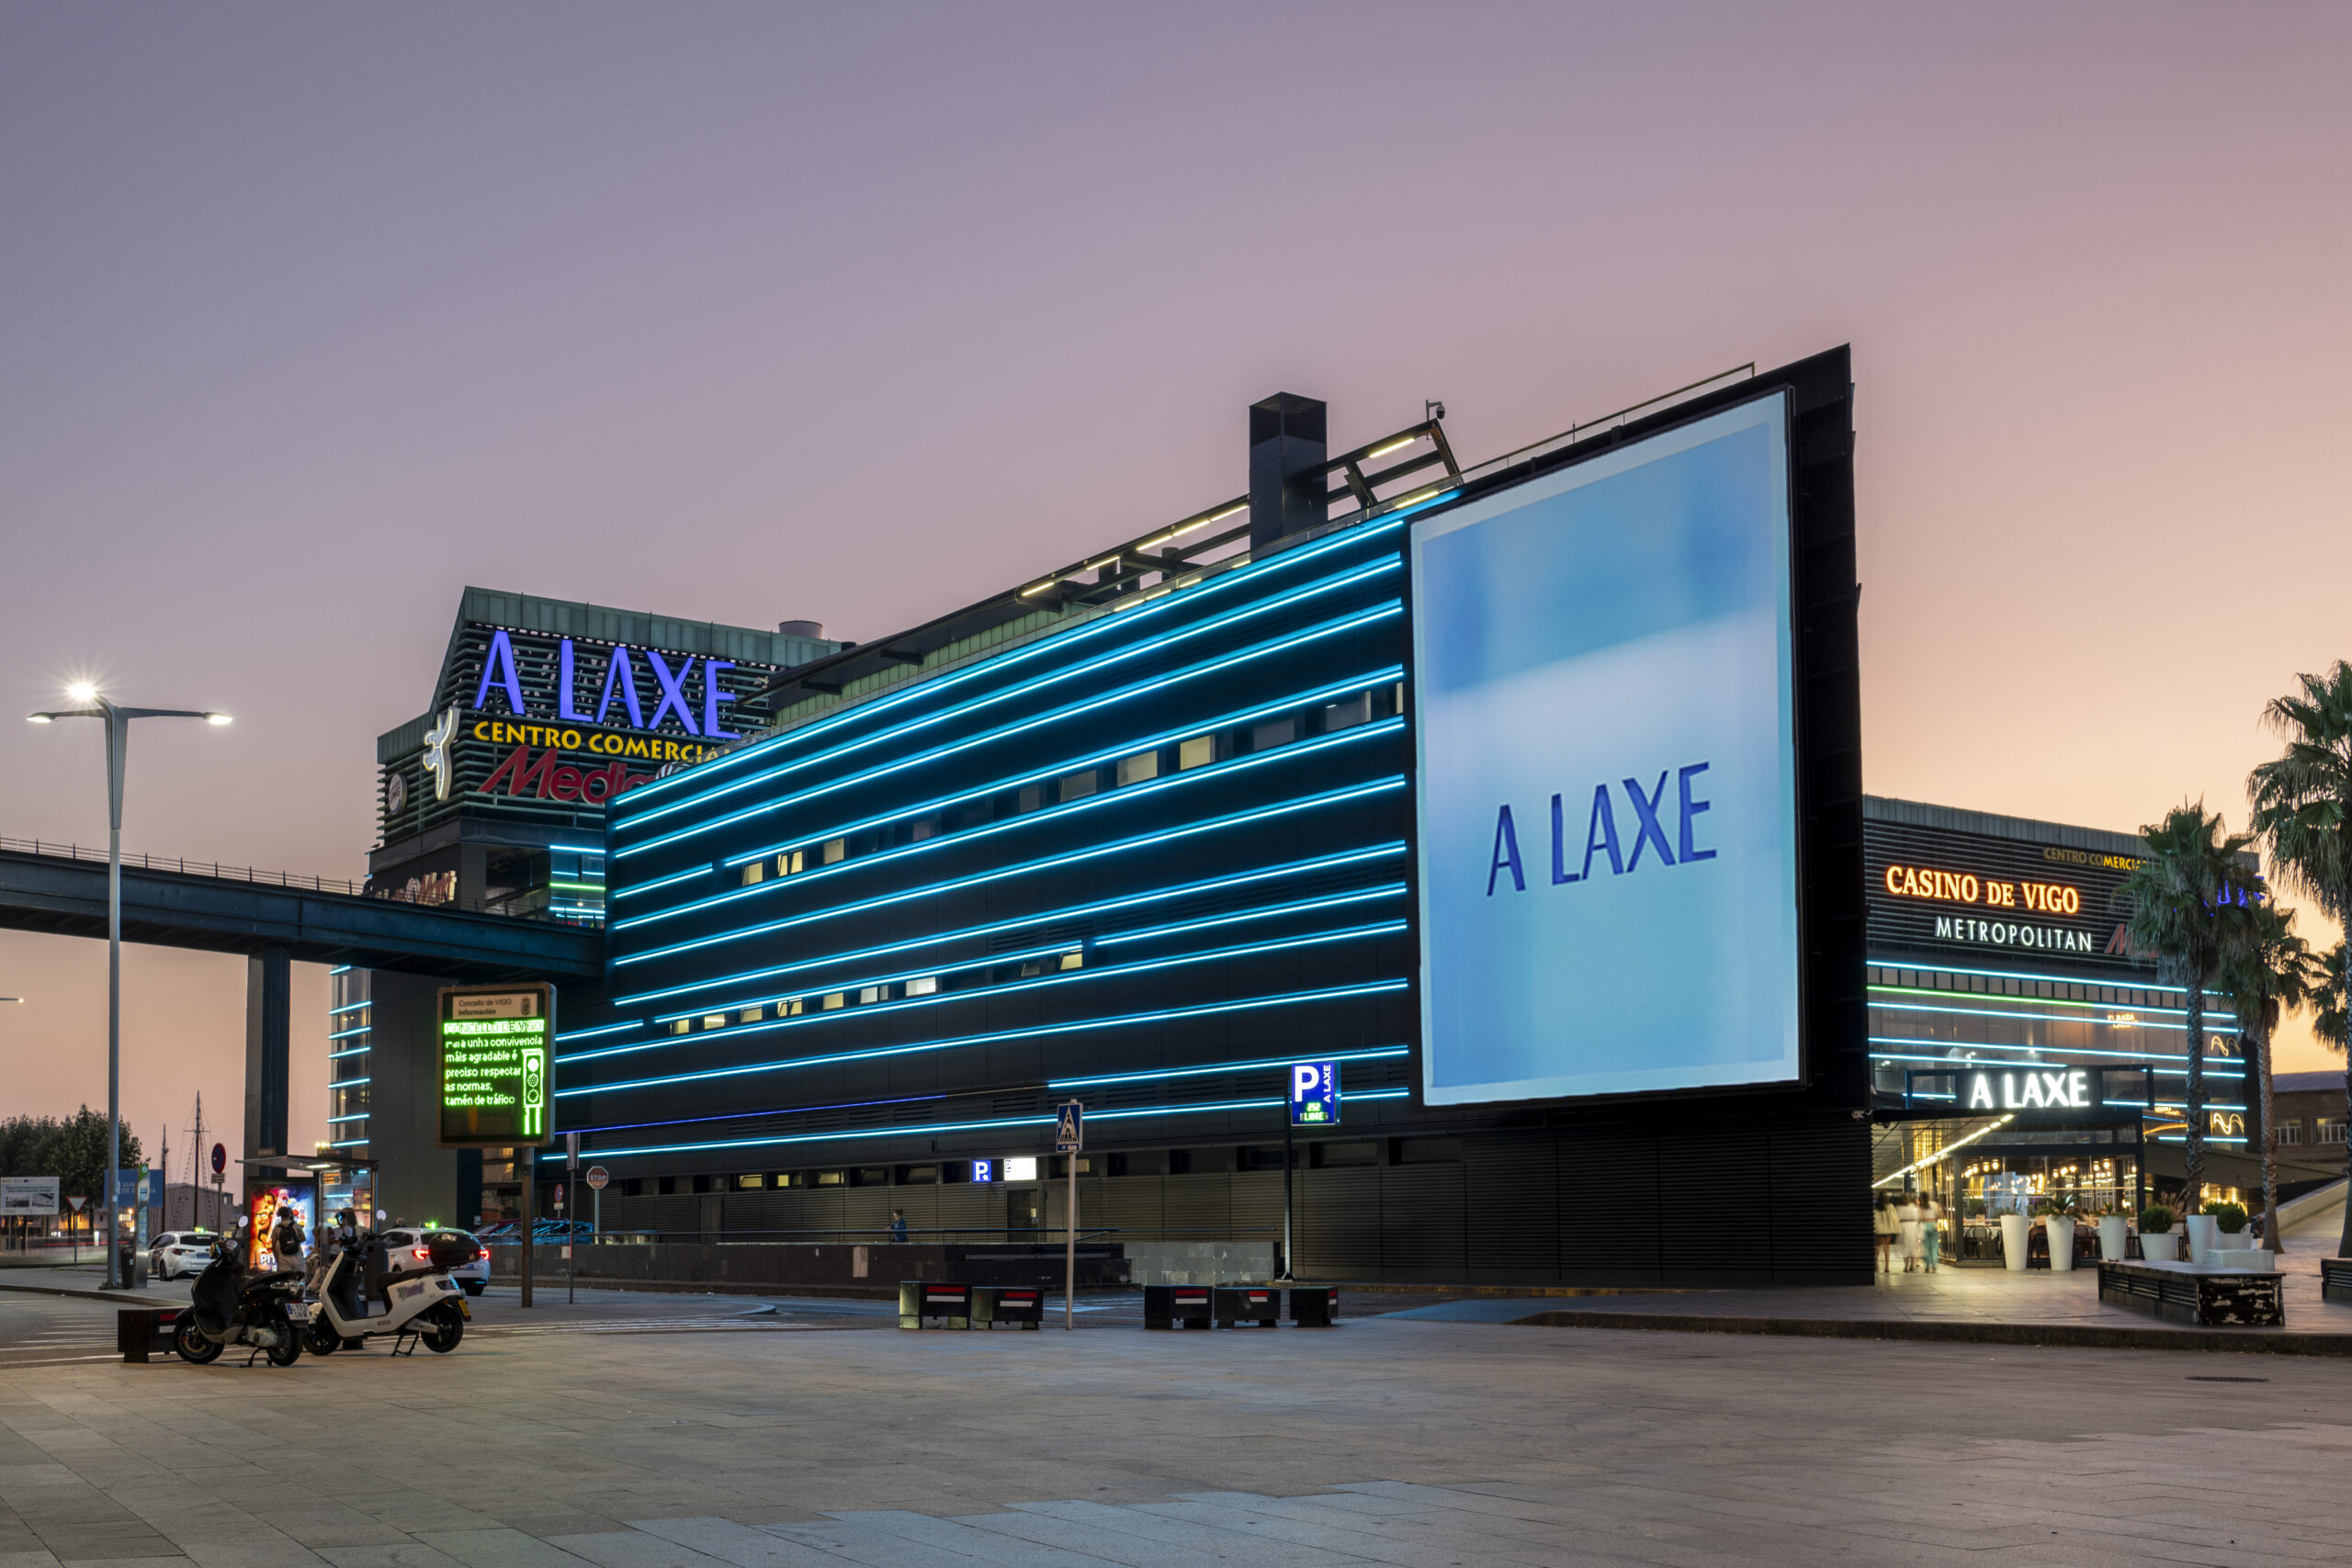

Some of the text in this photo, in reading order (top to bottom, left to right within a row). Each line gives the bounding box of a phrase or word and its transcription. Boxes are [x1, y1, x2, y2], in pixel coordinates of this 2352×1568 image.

[473, 630, 741, 740] A LAXE
[473, 721, 730, 764] CENTRO COMERCIA
[1487, 761, 1717, 897] A LAXE
[2043, 846, 2087, 865] CENTRO
[1886, 864, 2080, 915] CASINO DE VIGO
[1935, 916, 2092, 953] METROPOLITAN
[446, 1049, 518, 1064] máis agradable é
[490, 1036, 543, 1047] convivencia
[445, 1082, 493, 1092] as normas,
[446, 1066, 522, 1080] preciso respectar
[1295, 1066, 1319, 1102] P
[1323, 1065, 1331, 1103] A LAXE
[1970, 1071, 2090, 1109] A LAXE
[445, 1094, 515, 1106] tamén de tráfico
[975, 1161, 989, 1181] P
